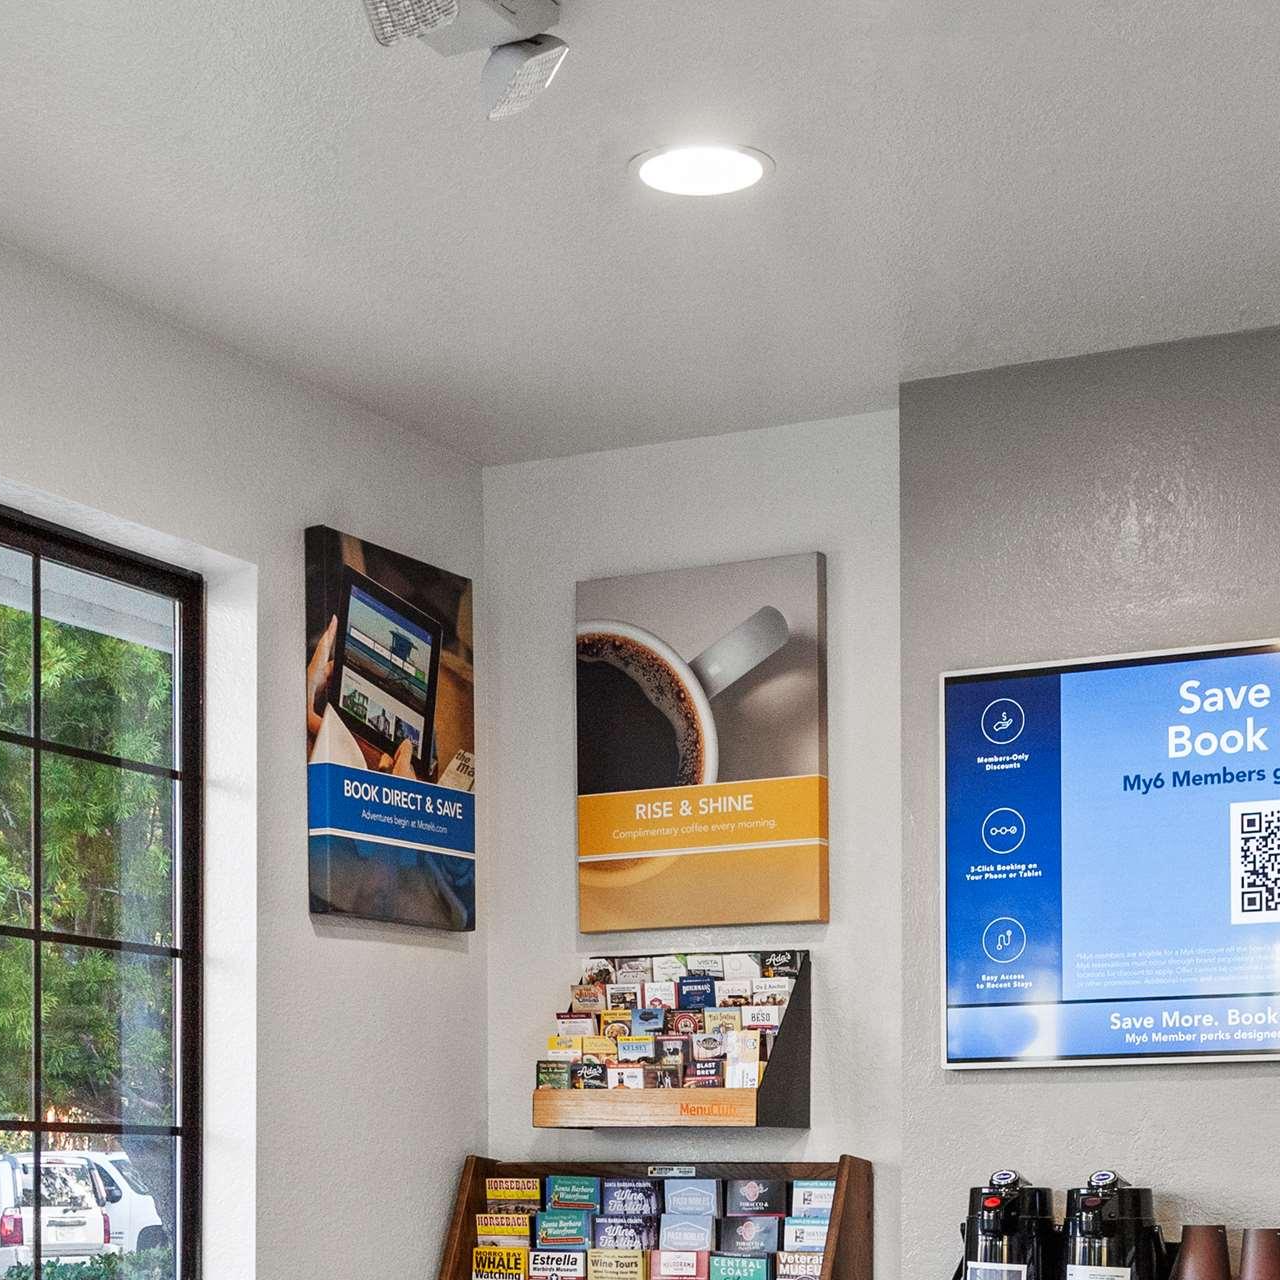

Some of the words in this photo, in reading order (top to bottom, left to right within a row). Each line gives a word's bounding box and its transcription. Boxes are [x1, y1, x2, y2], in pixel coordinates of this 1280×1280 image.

[1178, 680, 1271, 714] Save
[1168, 717, 1269, 758] Book
[456, 750, 470, 763] the
[977, 753, 1029, 763] Members-Only
[986, 762, 1020, 770] Discounts
[1123, 772, 1165, 794] My6
[1172, 766, 1266, 788] Members
[344, 779, 379, 802] BOOK
[383, 788, 422, 811] DIRECT
[425, 797, 433, 813] &
[437, 799, 462, 819] SAVE
[635, 802, 673, 820] RISE
[680, 800, 692, 816] &
[699, 794, 753, 814] SHINE
[361, 809, 393, 824] Adventures
[394, 816, 409, 828] begin
[612, 826, 679, 840] Complimentary
[681, 823, 709, 834] coffee
[711, 821, 735, 832] every
[738, 818, 777, 829] morning.
[1110, 1013, 1154, 1030] Save
[1162, 1011, 1218, 1028] More.
[1228, 1007, 1278, 1025] Book
[1125, 1032, 1148, 1045] My6
[1152, 1031, 1196, 1043] Member
[1200, 1030, 1231, 1044] perks
[488, 1179, 538, 1191] HORSEBACK
[478, 1217, 528, 1227] HORSEBACK
[476, 1257, 522, 1270] WHALE
[532, 1254, 578, 1266] Estrella
[592, 1260, 613, 1268] Wine
[616, 1261, 638, 1269] Tours
[714, 1259, 761, 1269] CENTRAL
[720, 1268, 754, 1276] COAST
